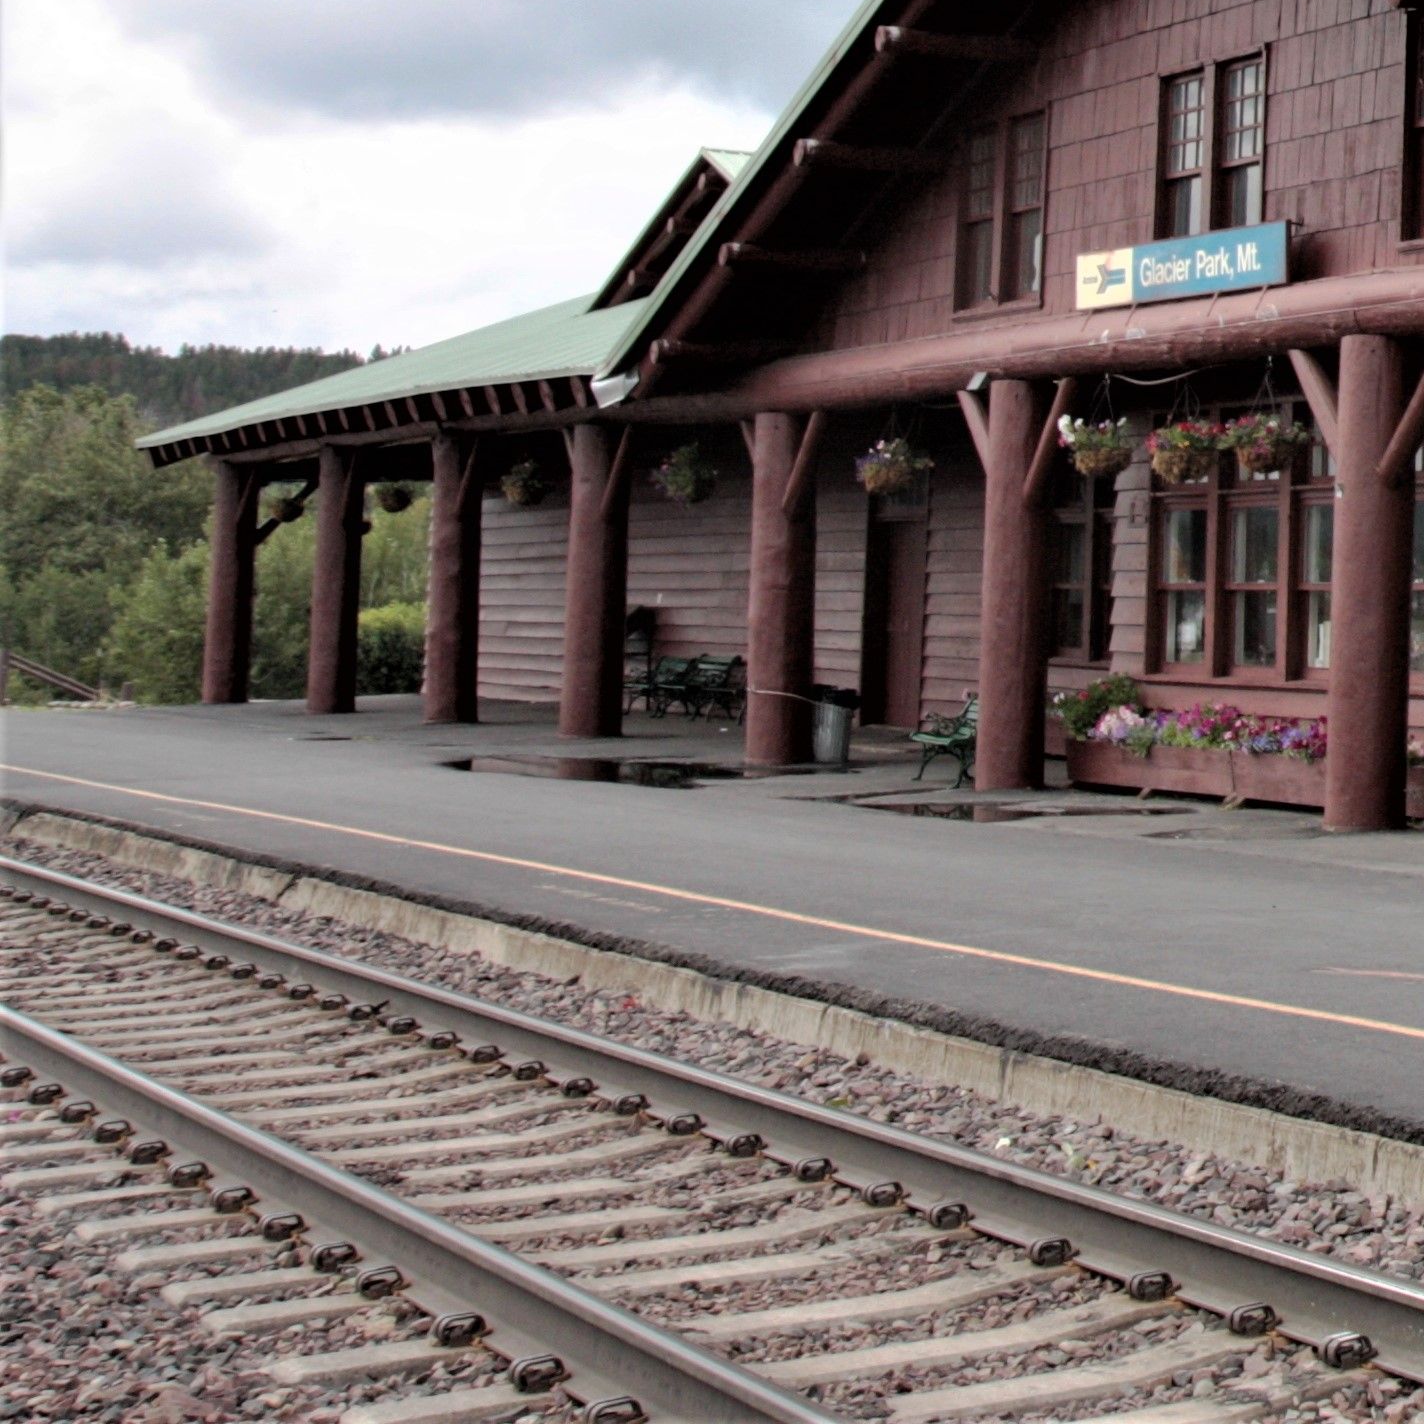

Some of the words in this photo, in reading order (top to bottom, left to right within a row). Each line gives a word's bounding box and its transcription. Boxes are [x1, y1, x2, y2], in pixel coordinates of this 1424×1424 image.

[1140, 254, 1191, 287] Glacier
[1196, 246, 1234, 281] Park,
[1237, 242, 1261, 273] Mt.
